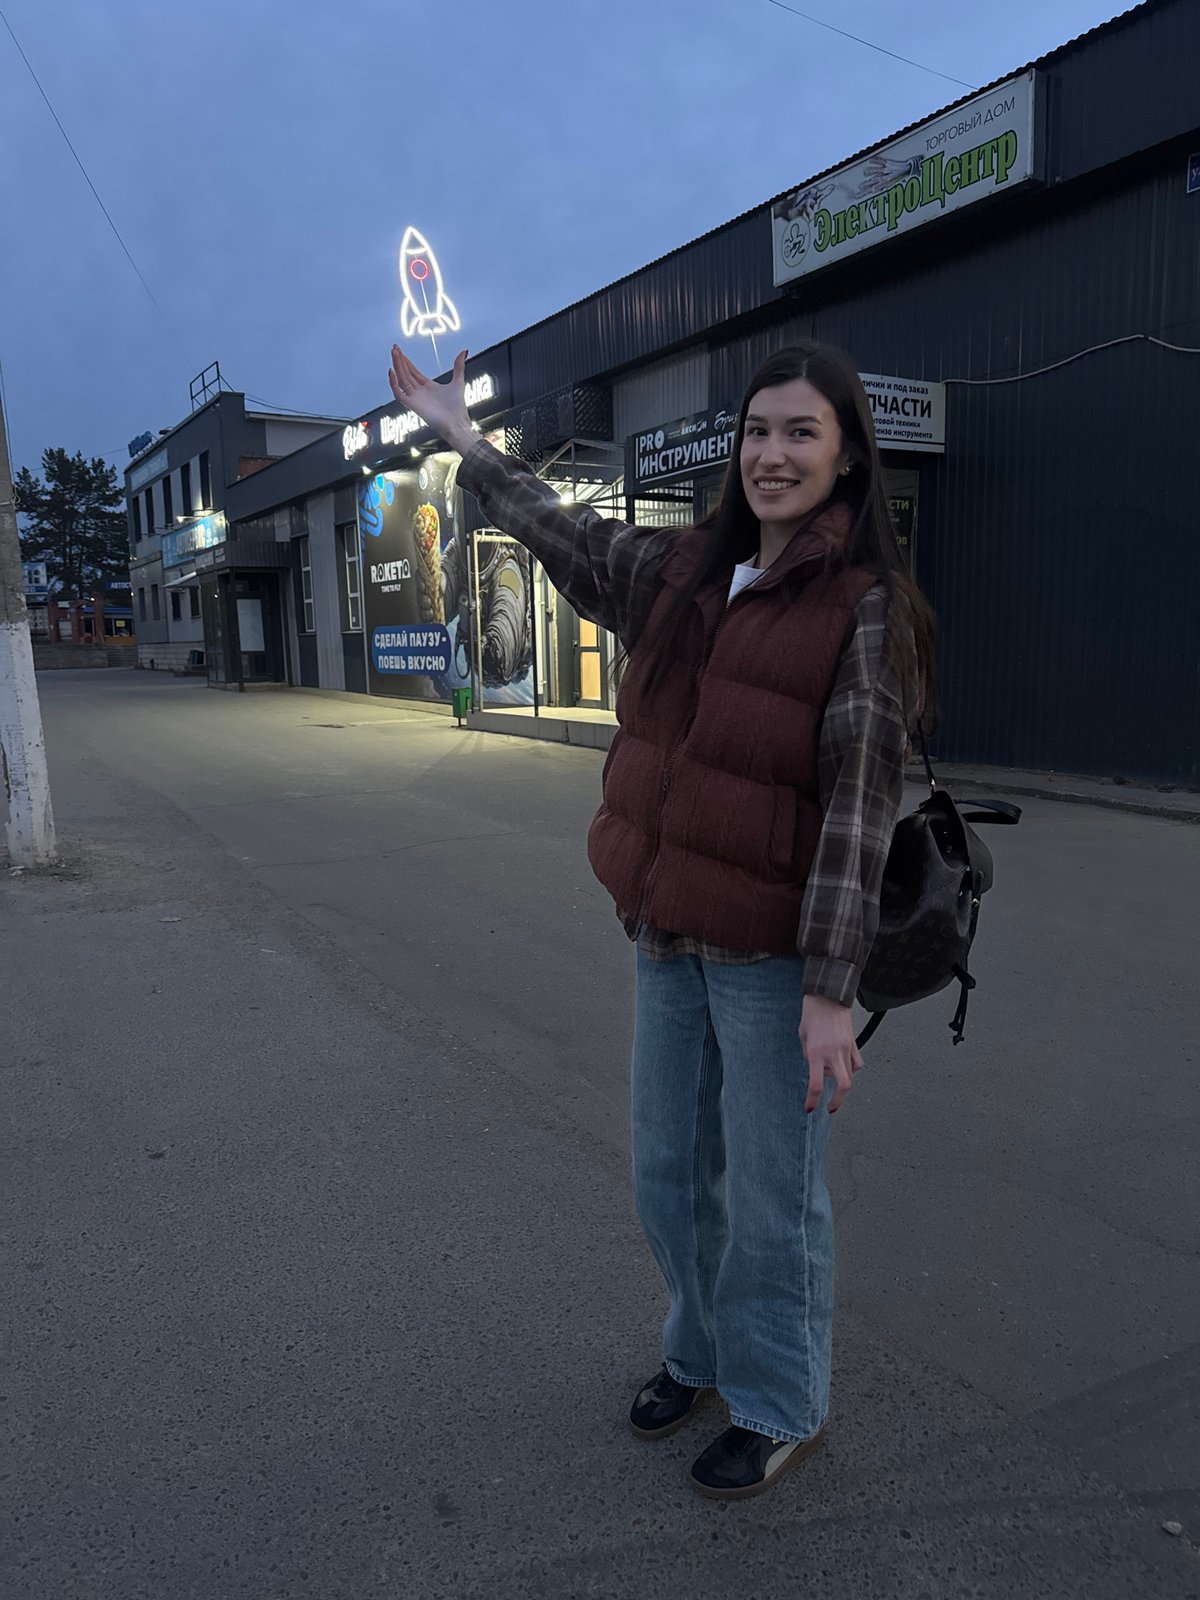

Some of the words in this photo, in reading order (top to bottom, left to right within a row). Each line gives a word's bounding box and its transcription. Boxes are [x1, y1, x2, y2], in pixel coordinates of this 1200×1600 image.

[925, 110, 983, 150] ТОРГОВЫЙ
[983, 97, 1016, 126] ДОМ
[813, 130, 1018, 252] ЭлектроЦентр
[893, 383, 908, 394] под
[909, 385, 929, 395] заказ
[867, 393, 932, 418] ПЧАСТИ
[896, 419, 921, 428] техники
[893, 428, 933, 439] инструмента
[374, 631, 408, 649] СДЕЛАЙ
[378, 655, 407, 670] ПОЕШЬ
[408, 655, 446, 671] ВКУСНО
